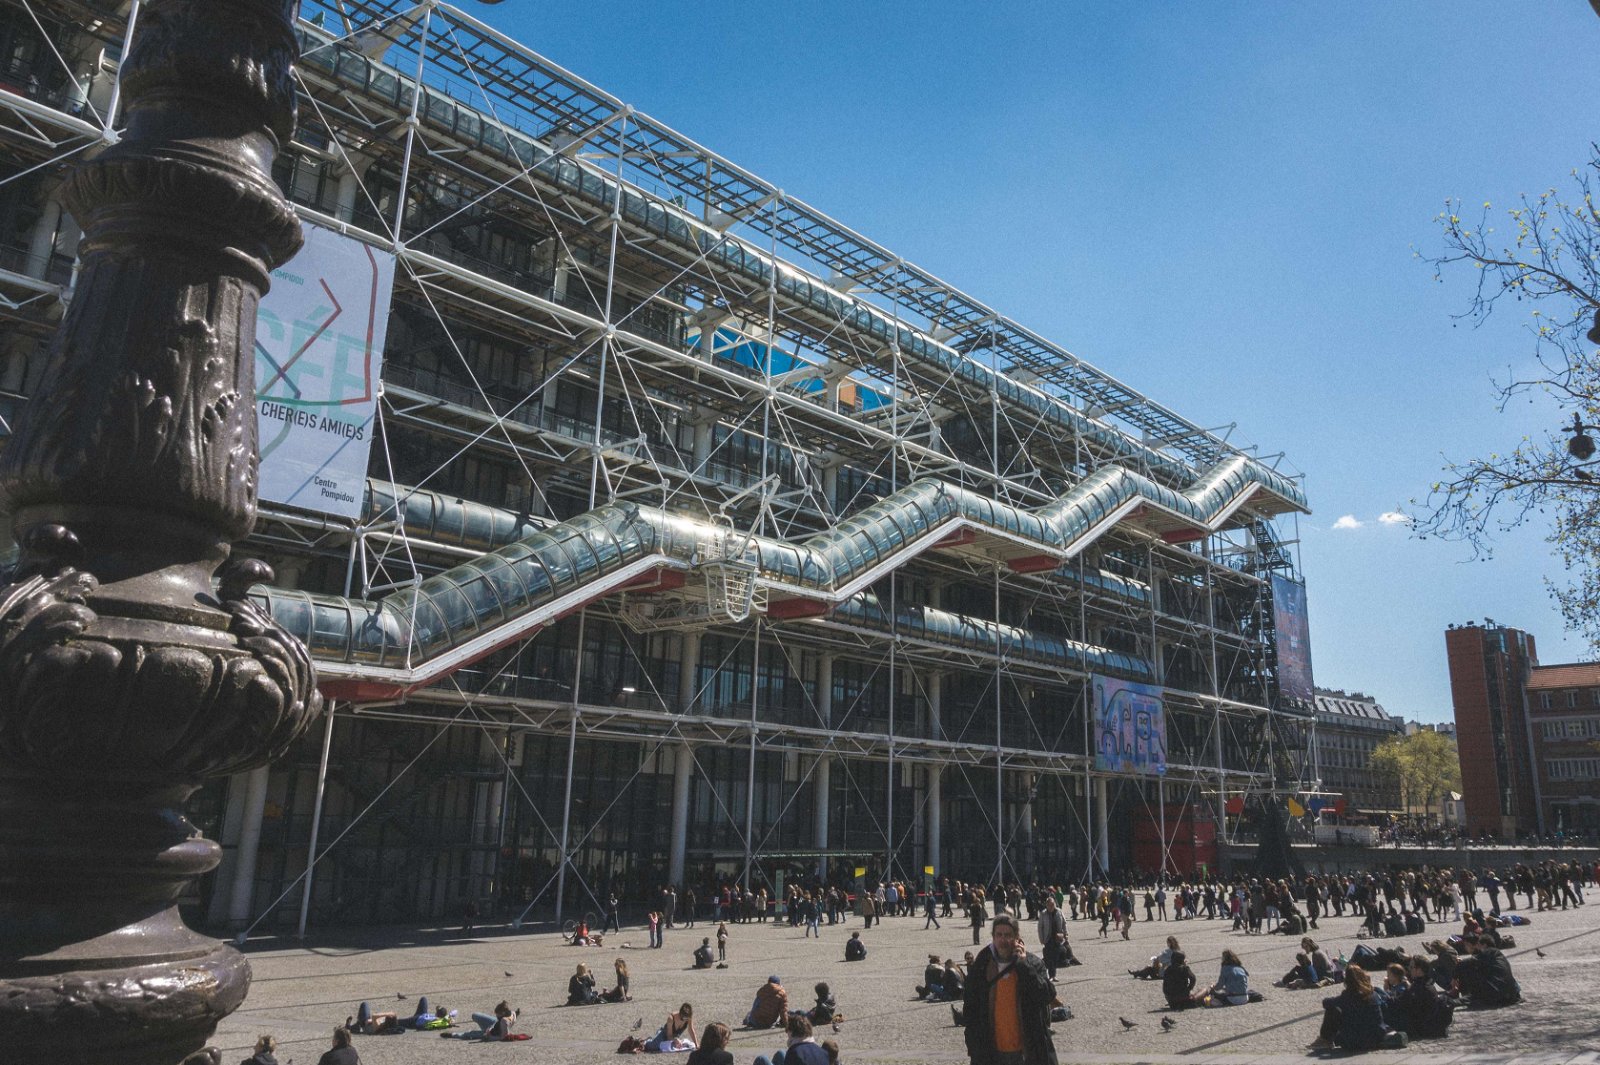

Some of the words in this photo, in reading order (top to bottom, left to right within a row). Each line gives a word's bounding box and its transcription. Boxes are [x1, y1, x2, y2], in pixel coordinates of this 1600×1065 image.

[261, 401, 318, 428] CHER(E)S
[319, 416, 364, 441] AMI(E)S
[314, 475, 338, 489] Centre
[320, 487, 355, 503] Pompidou
